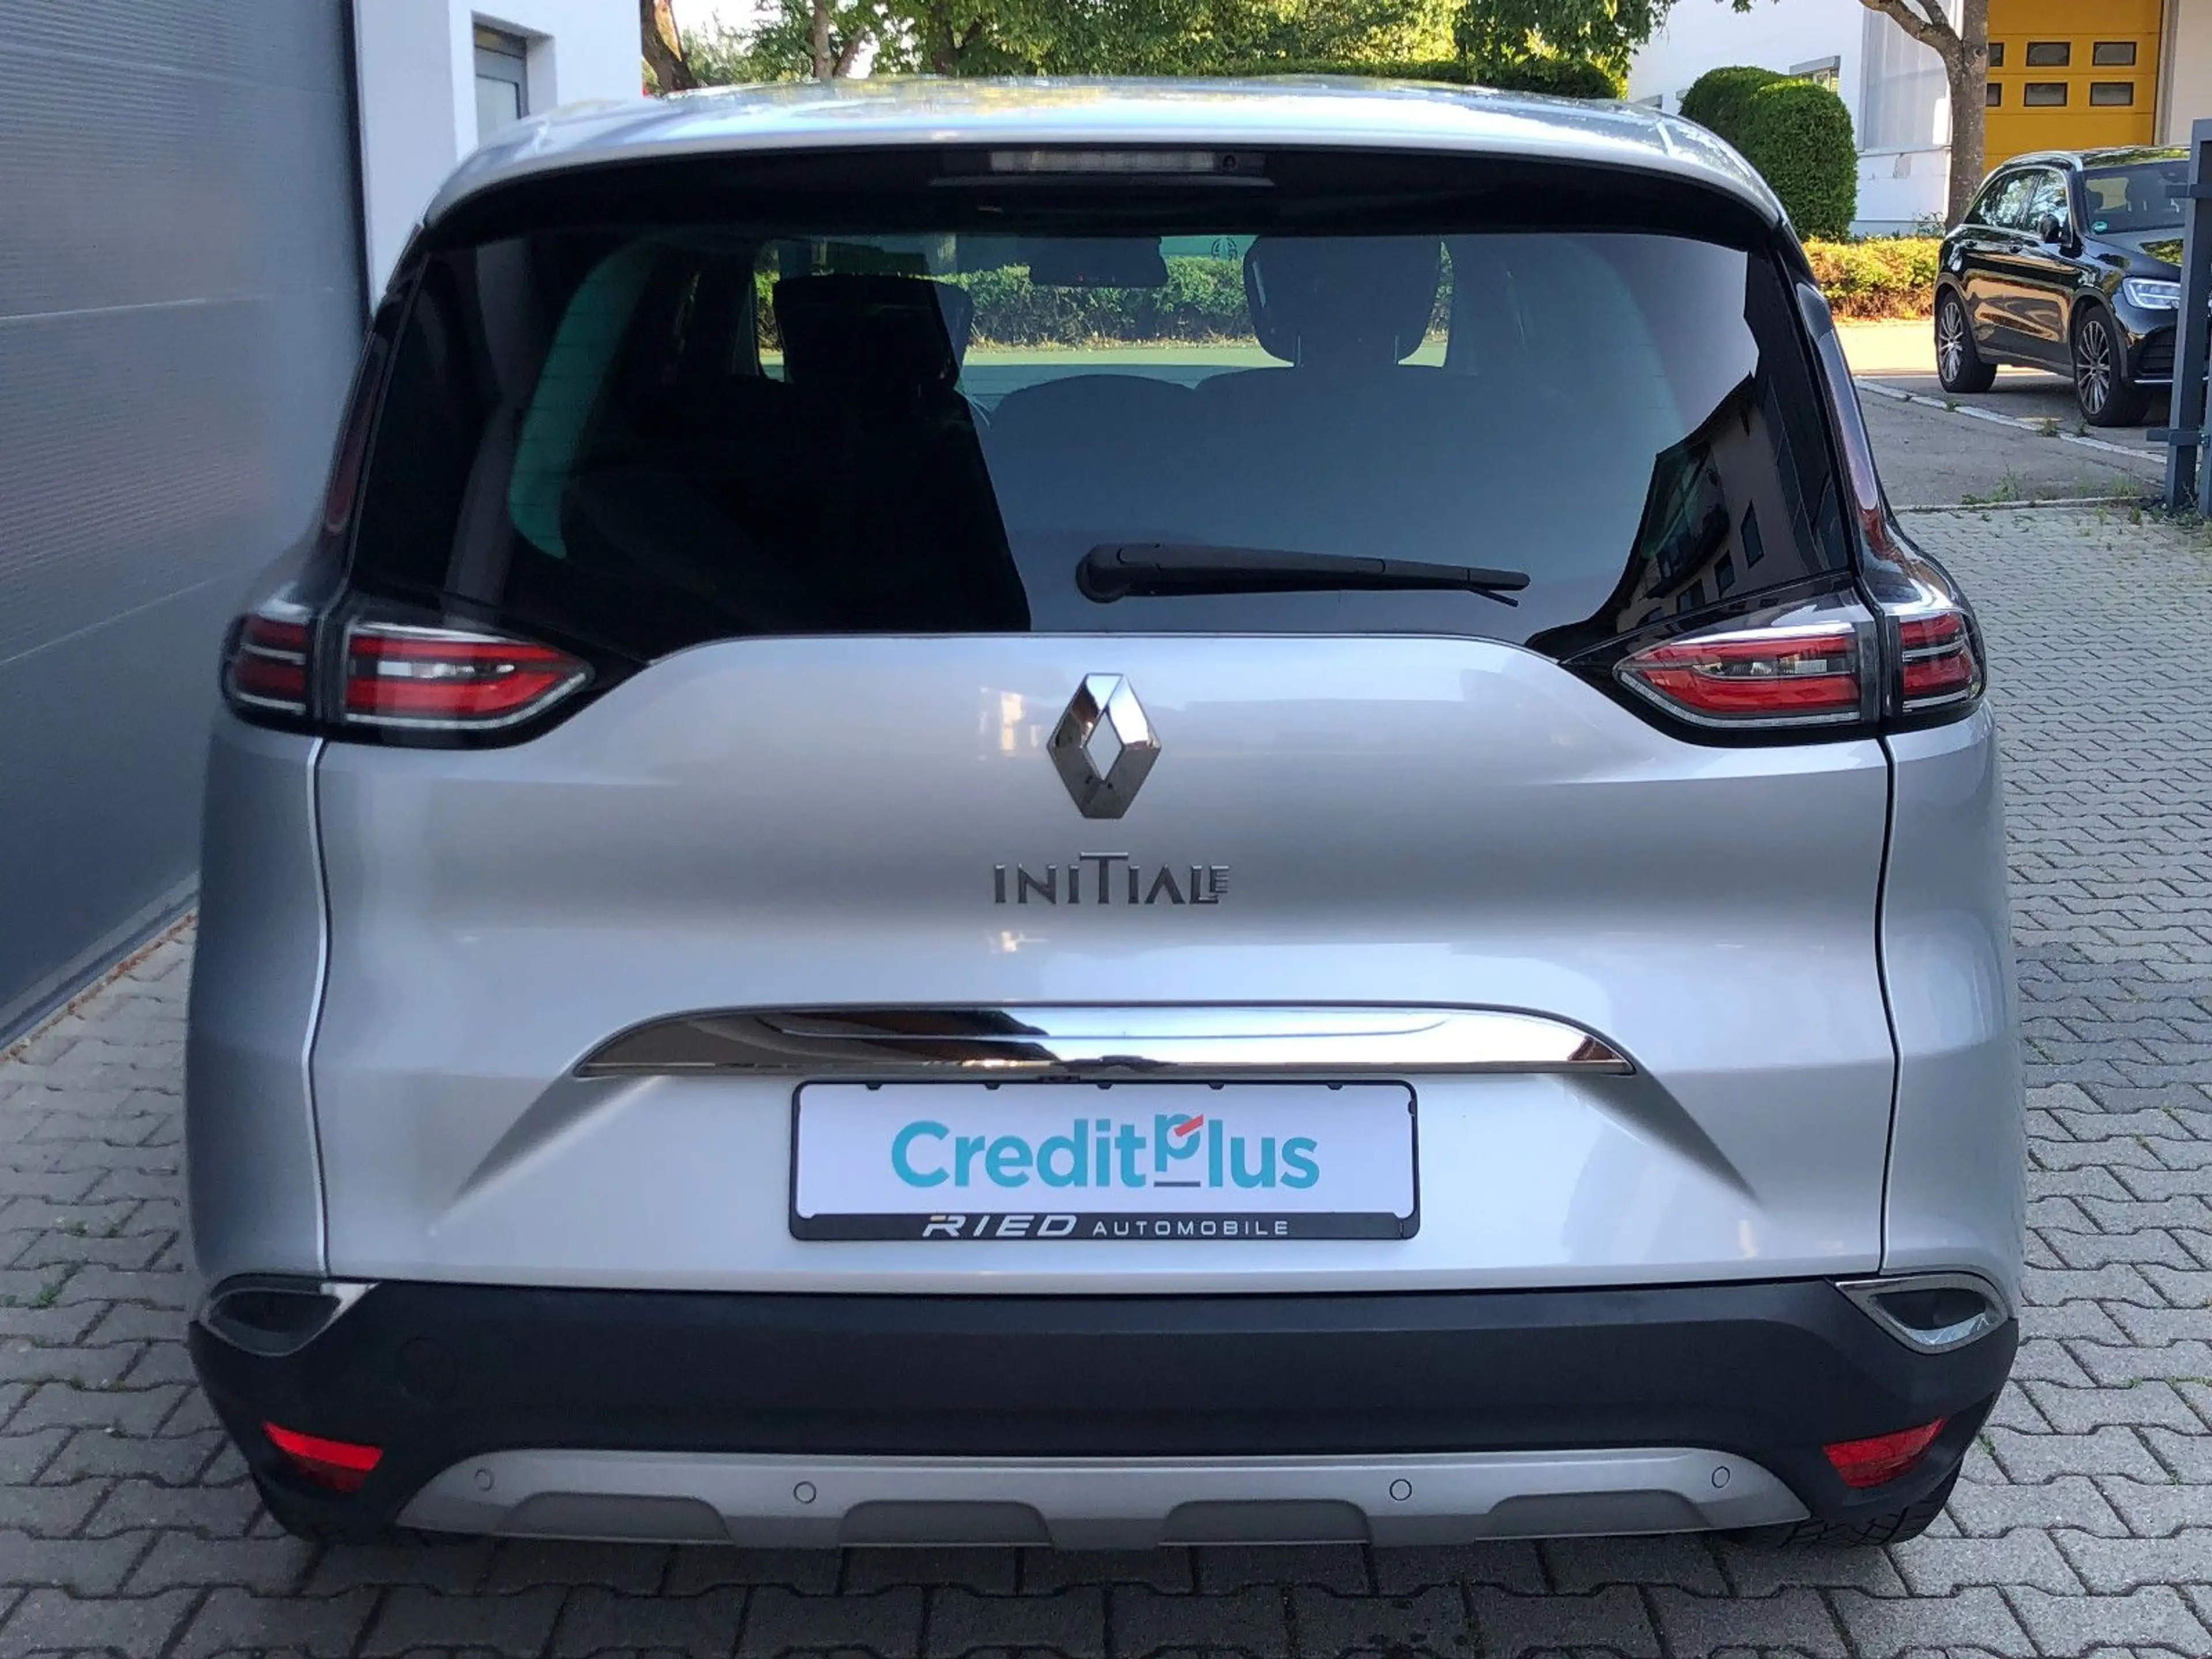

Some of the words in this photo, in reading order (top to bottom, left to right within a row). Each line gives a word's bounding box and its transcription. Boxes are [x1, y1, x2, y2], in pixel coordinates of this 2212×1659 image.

[994, 851, 1229, 904] INITIALE
[922, 1214, 1077, 1237] RIED
[1092, 1220, 1289, 1236] AUTOMOBILE
